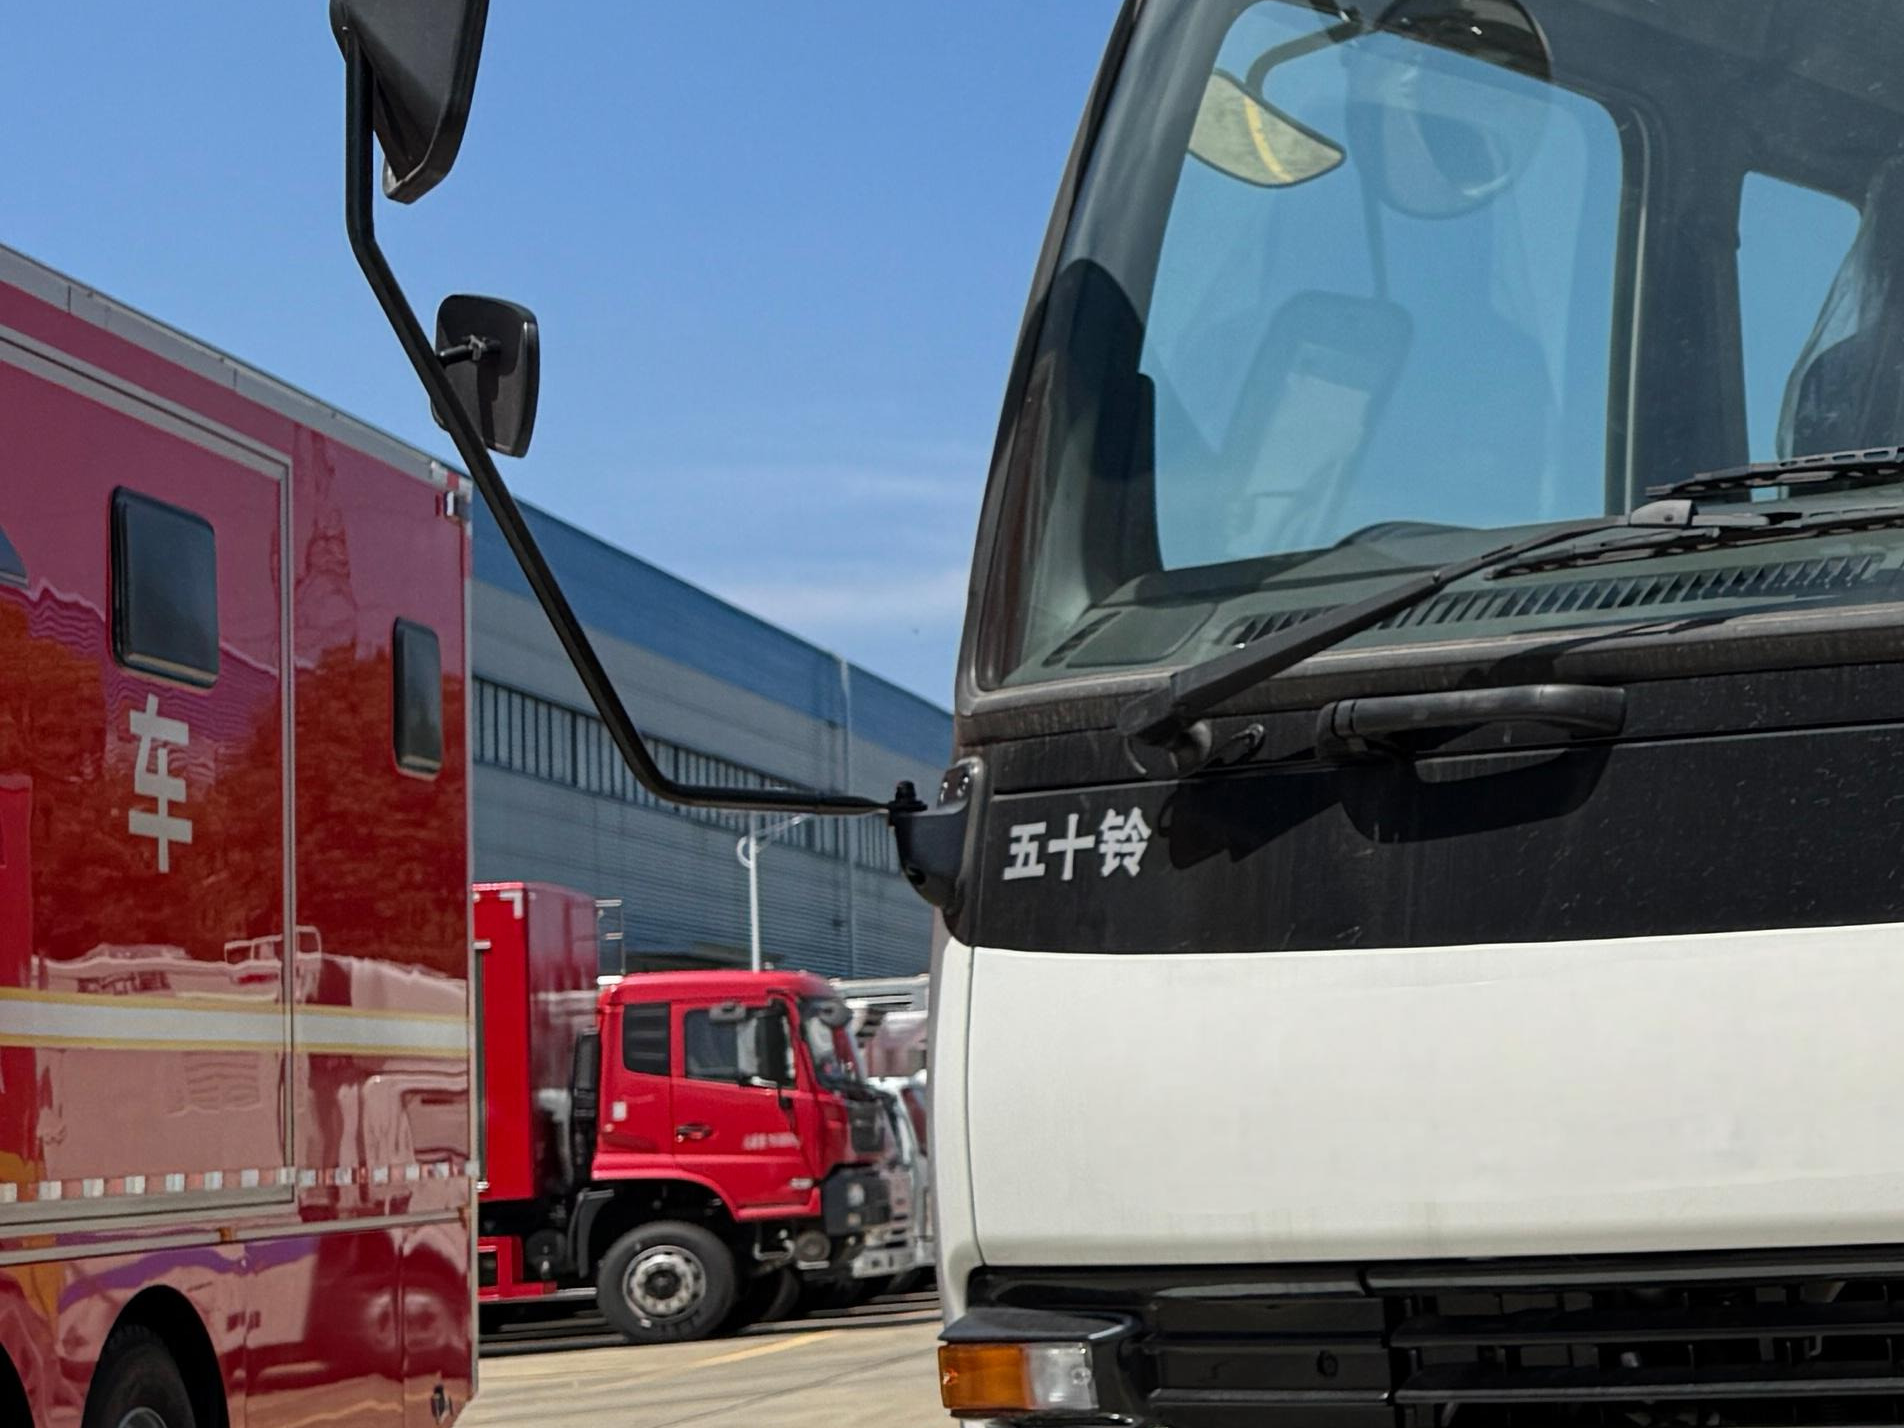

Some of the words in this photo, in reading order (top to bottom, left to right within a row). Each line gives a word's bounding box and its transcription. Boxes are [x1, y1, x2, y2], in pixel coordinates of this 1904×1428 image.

[129, 693, 192, 873] 车
[1003, 806, 1152, 881] 五十铃
